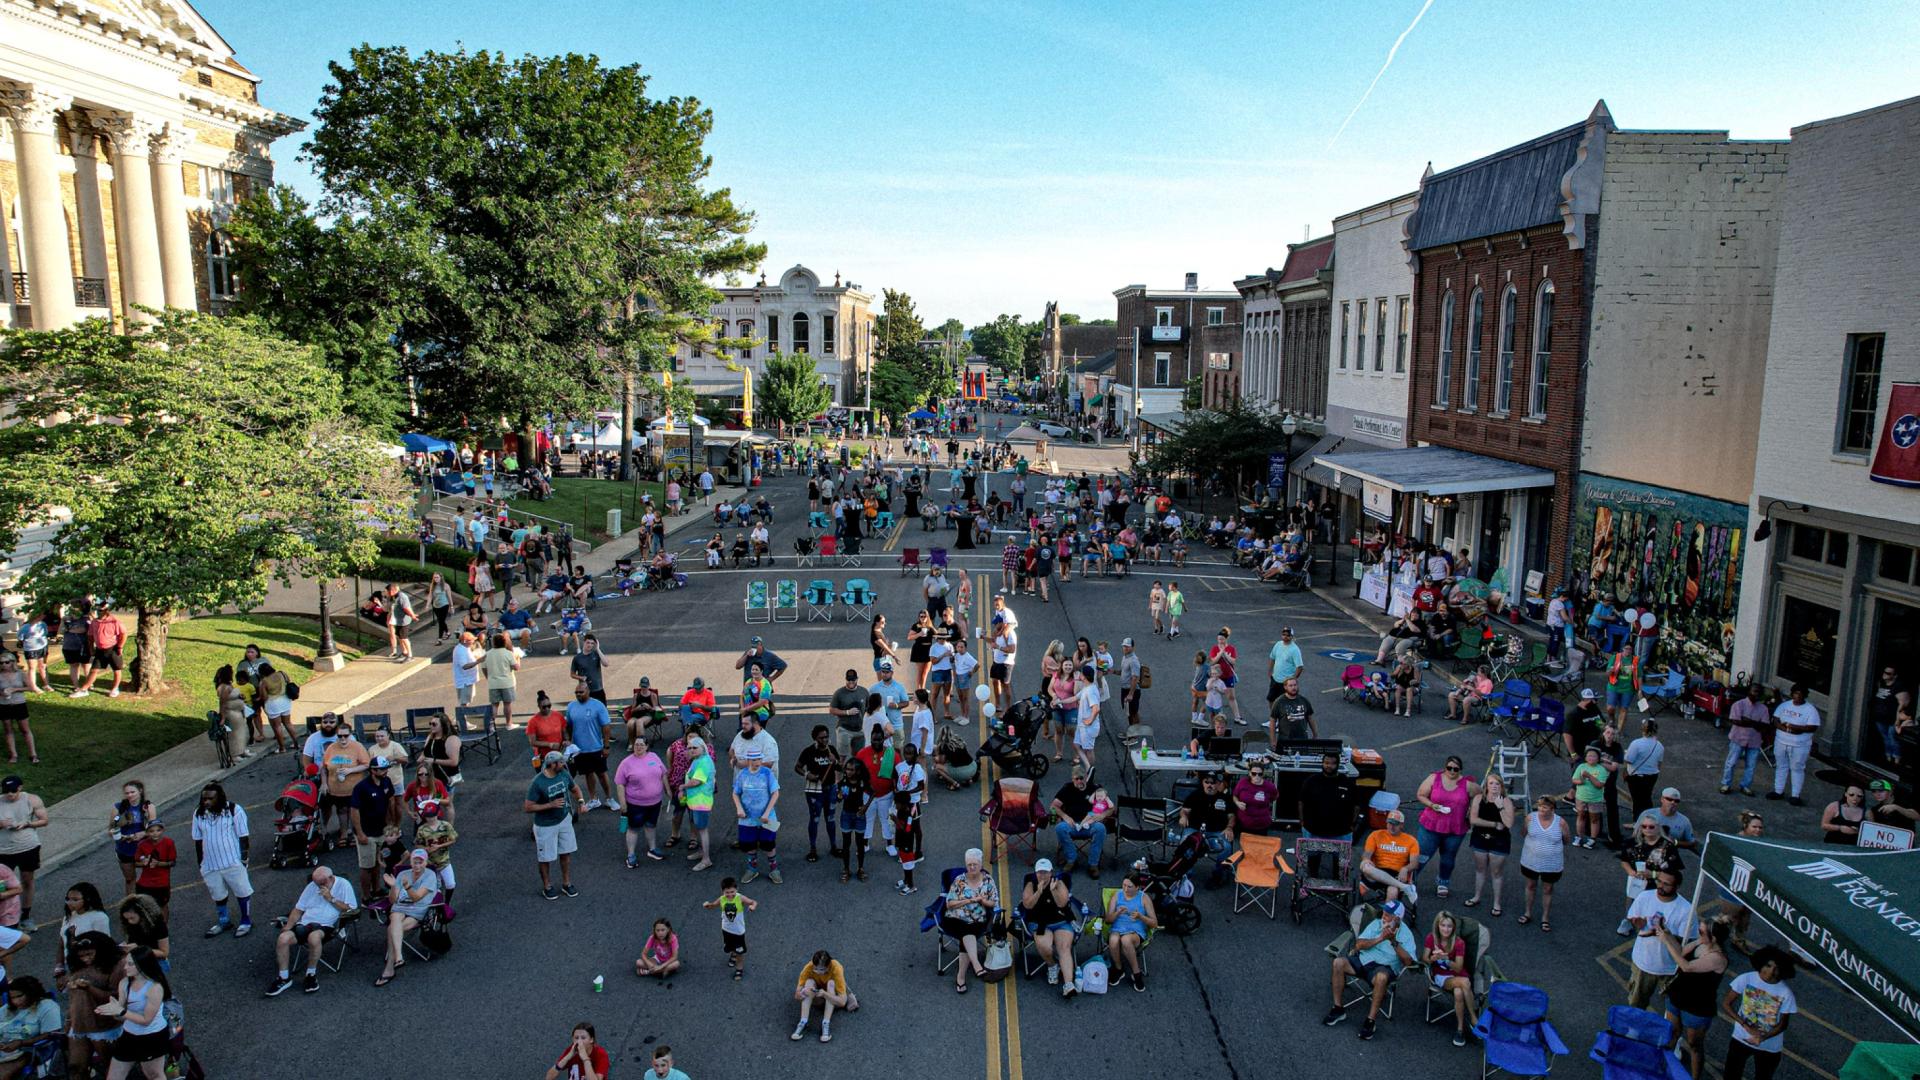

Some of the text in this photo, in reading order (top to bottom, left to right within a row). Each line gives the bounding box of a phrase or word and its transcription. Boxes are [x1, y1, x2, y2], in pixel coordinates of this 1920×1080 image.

[1876, 830, 1895, 843] NO
[1754, 878, 1920, 1023] BANK OF FRANKEWIN
